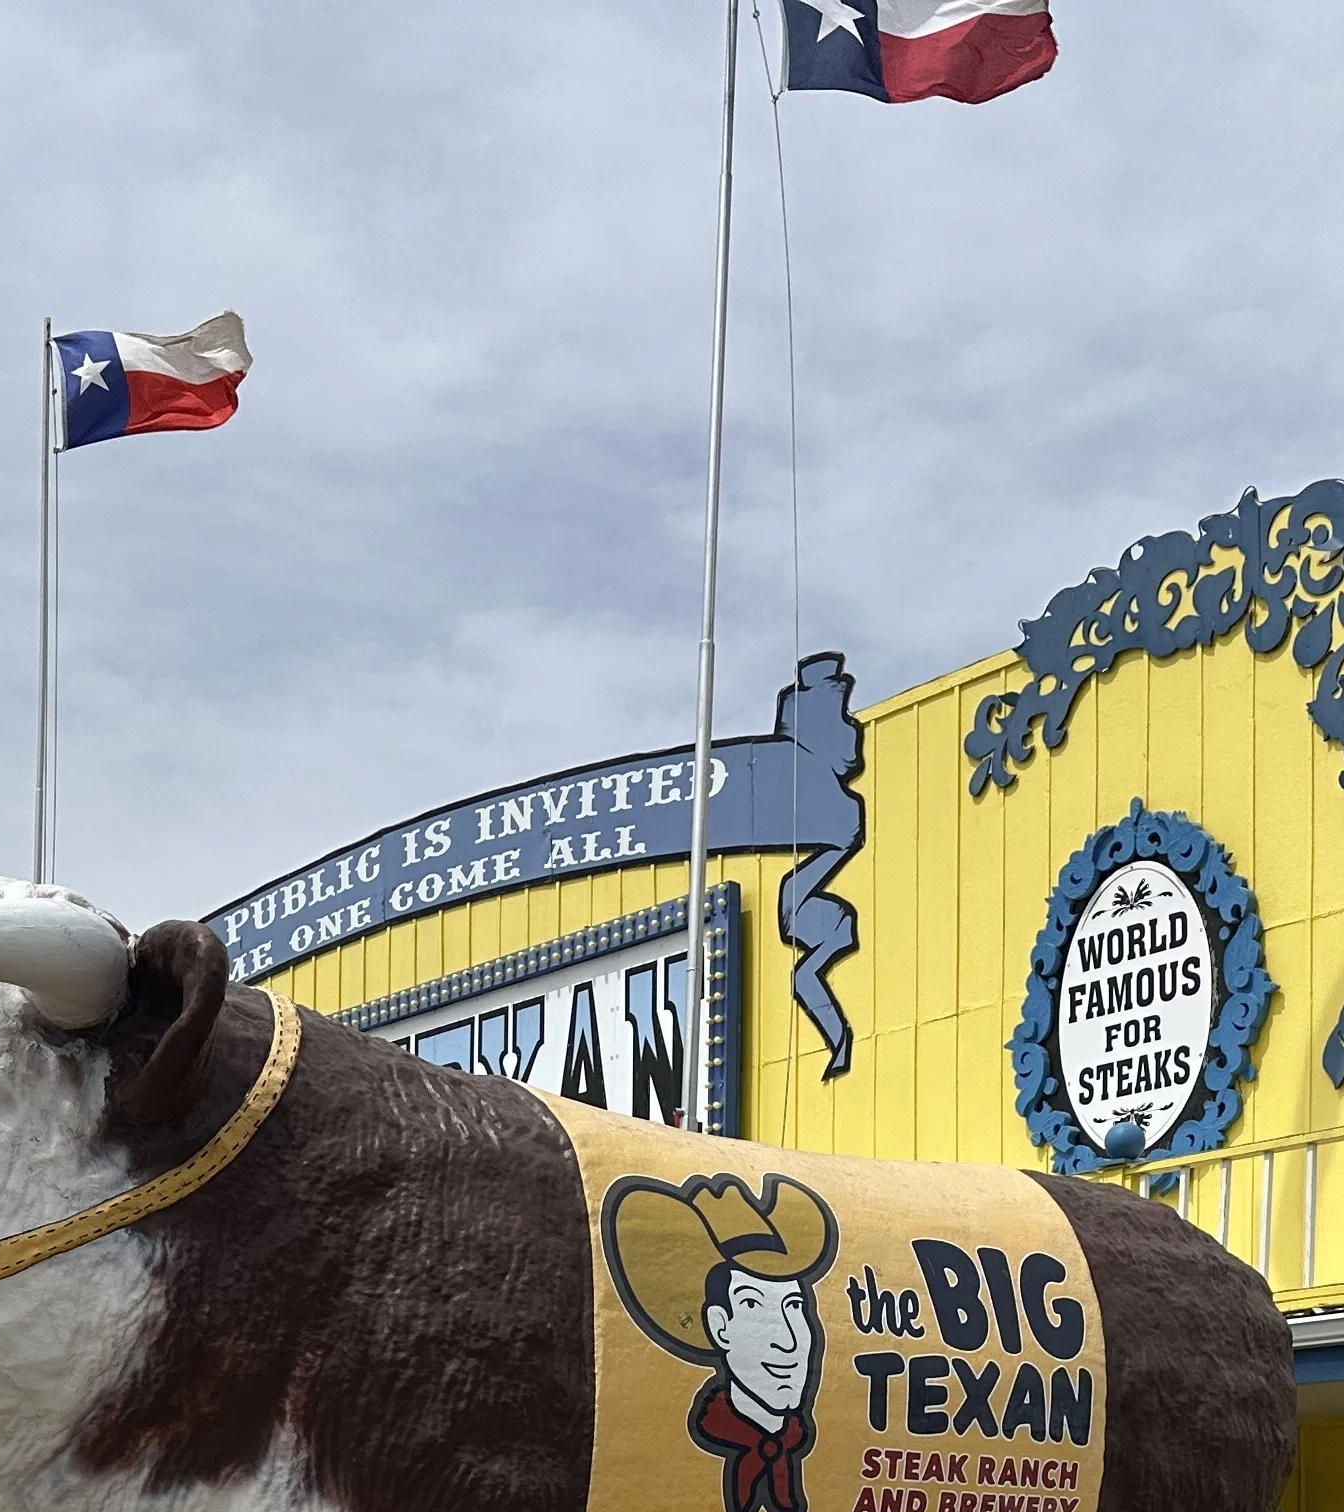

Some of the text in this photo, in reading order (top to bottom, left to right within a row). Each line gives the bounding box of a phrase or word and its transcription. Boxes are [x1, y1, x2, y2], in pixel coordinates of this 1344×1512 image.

[223, 757, 729, 947] PUBLIC IS INVITED
[288, 897, 372, 952] ONE
[389, 848, 521, 912] COME
[543, 825, 647, 869] ALL
[1077, 910, 1189, 972] WORLD
[1068, 956, 1202, 1024] FAMOUS
[1104, 1014, 1162, 1053] FOR
[1078, 1045, 1191, 1106] STEAKS
[846, 1238, 1086, 1360] the BIG
[854, 1352, 1093, 1447] TEXAN
[861, 1448, 1079, 1490] STEAK RANCH
